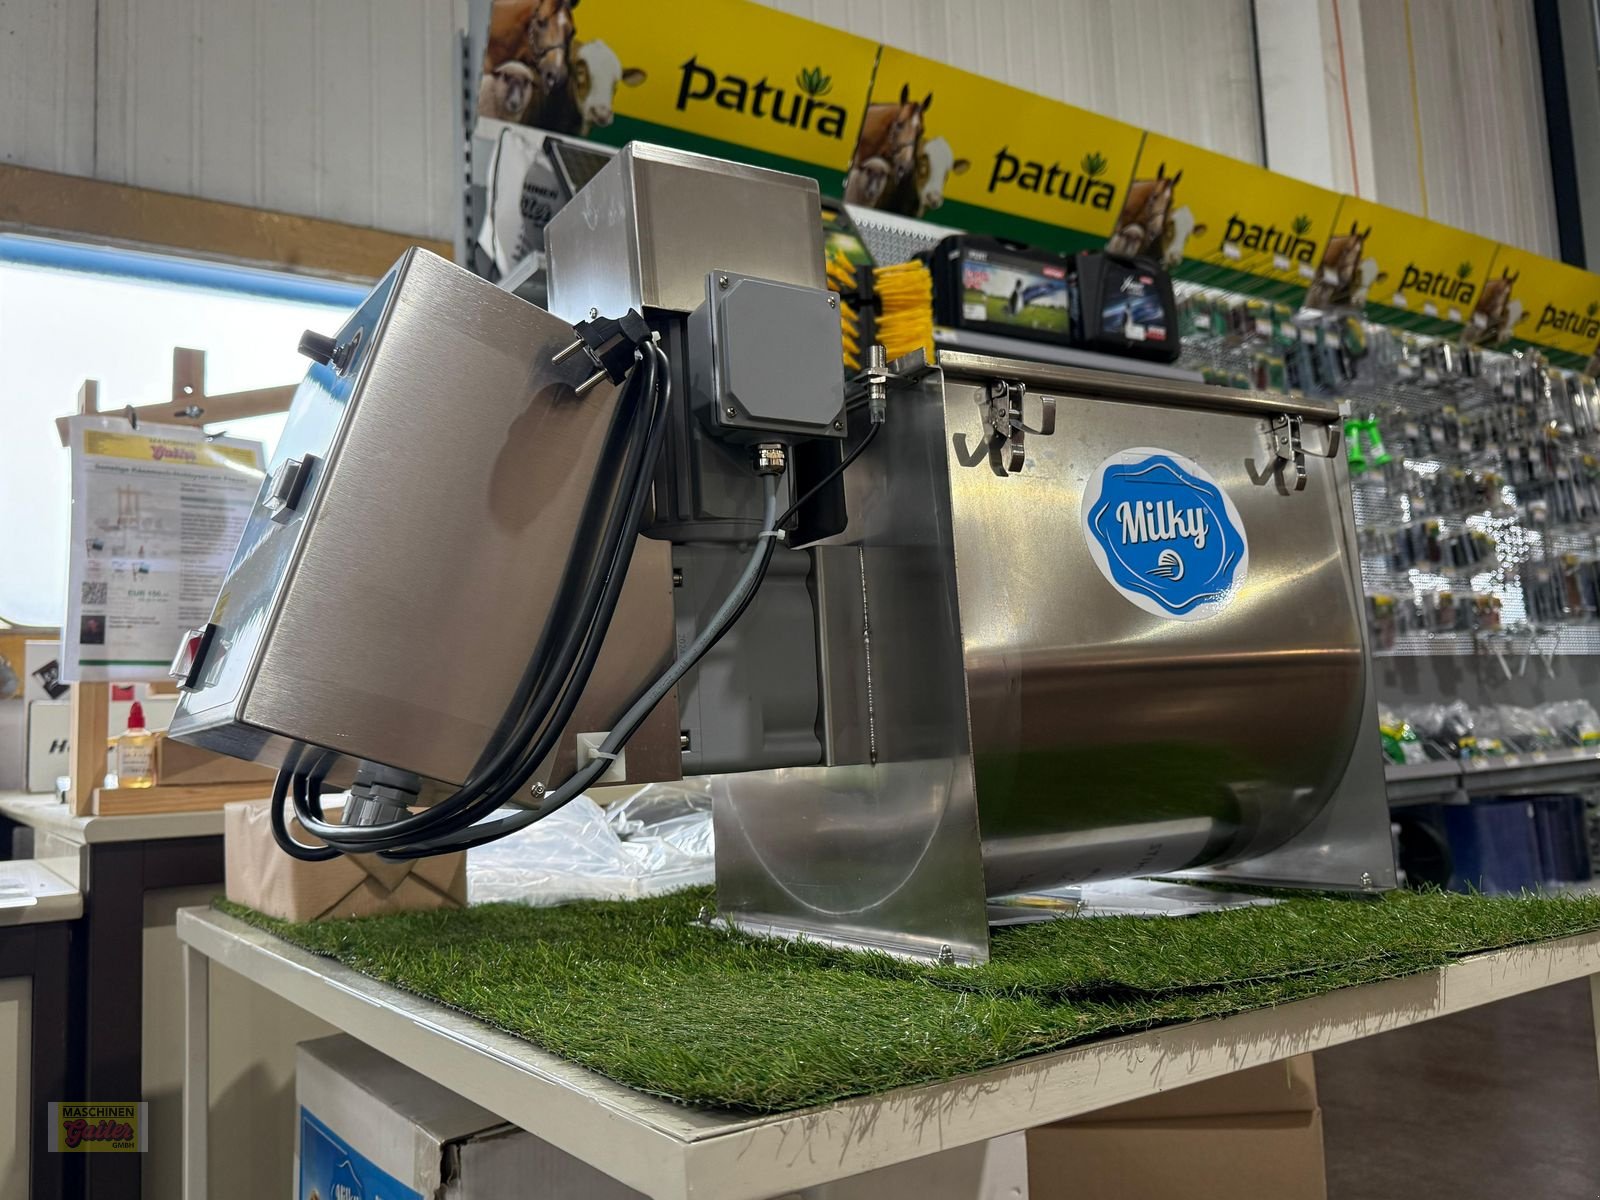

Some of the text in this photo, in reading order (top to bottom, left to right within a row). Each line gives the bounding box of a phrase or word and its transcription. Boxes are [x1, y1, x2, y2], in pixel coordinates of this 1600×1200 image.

[676, 55, 847, 140] patura
[988, 145, 1116, 212] patura
[1220, 211, 1316, 263] patura
[1398, 262, 1475, 305] patura
[1536, 302, 1600, 339] patura
[1115, 500, 1209, 549] Milky
